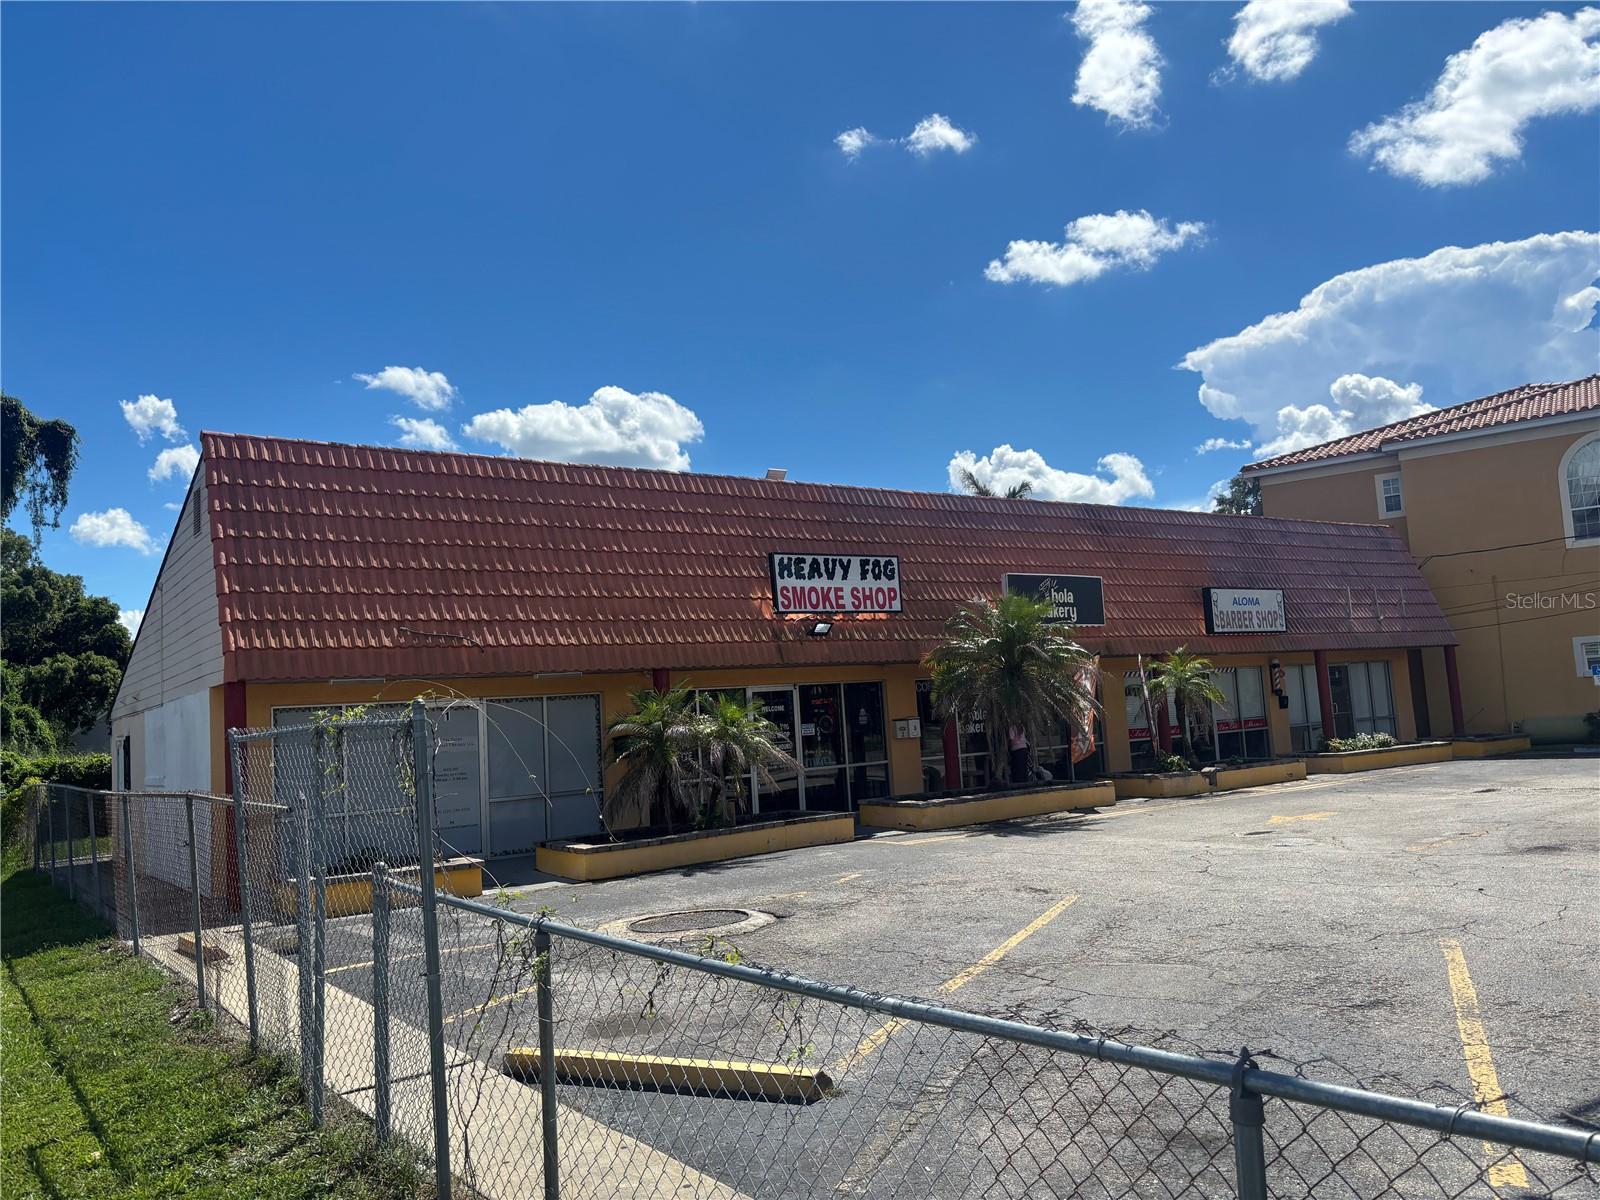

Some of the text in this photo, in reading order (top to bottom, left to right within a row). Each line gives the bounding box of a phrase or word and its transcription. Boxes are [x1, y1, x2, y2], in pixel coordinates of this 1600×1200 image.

[777, 557, 896, 581] HEAVY FOG
[780, 586, 897, 610] SMOKE SHOP
[1232, 597, 1260, 606] ALOMA
[1040, 604, 1077, 622] akery
[1219, 610, 1278, 629] BARBER SHOP
[761, 704, 785, 713] WELCOME
